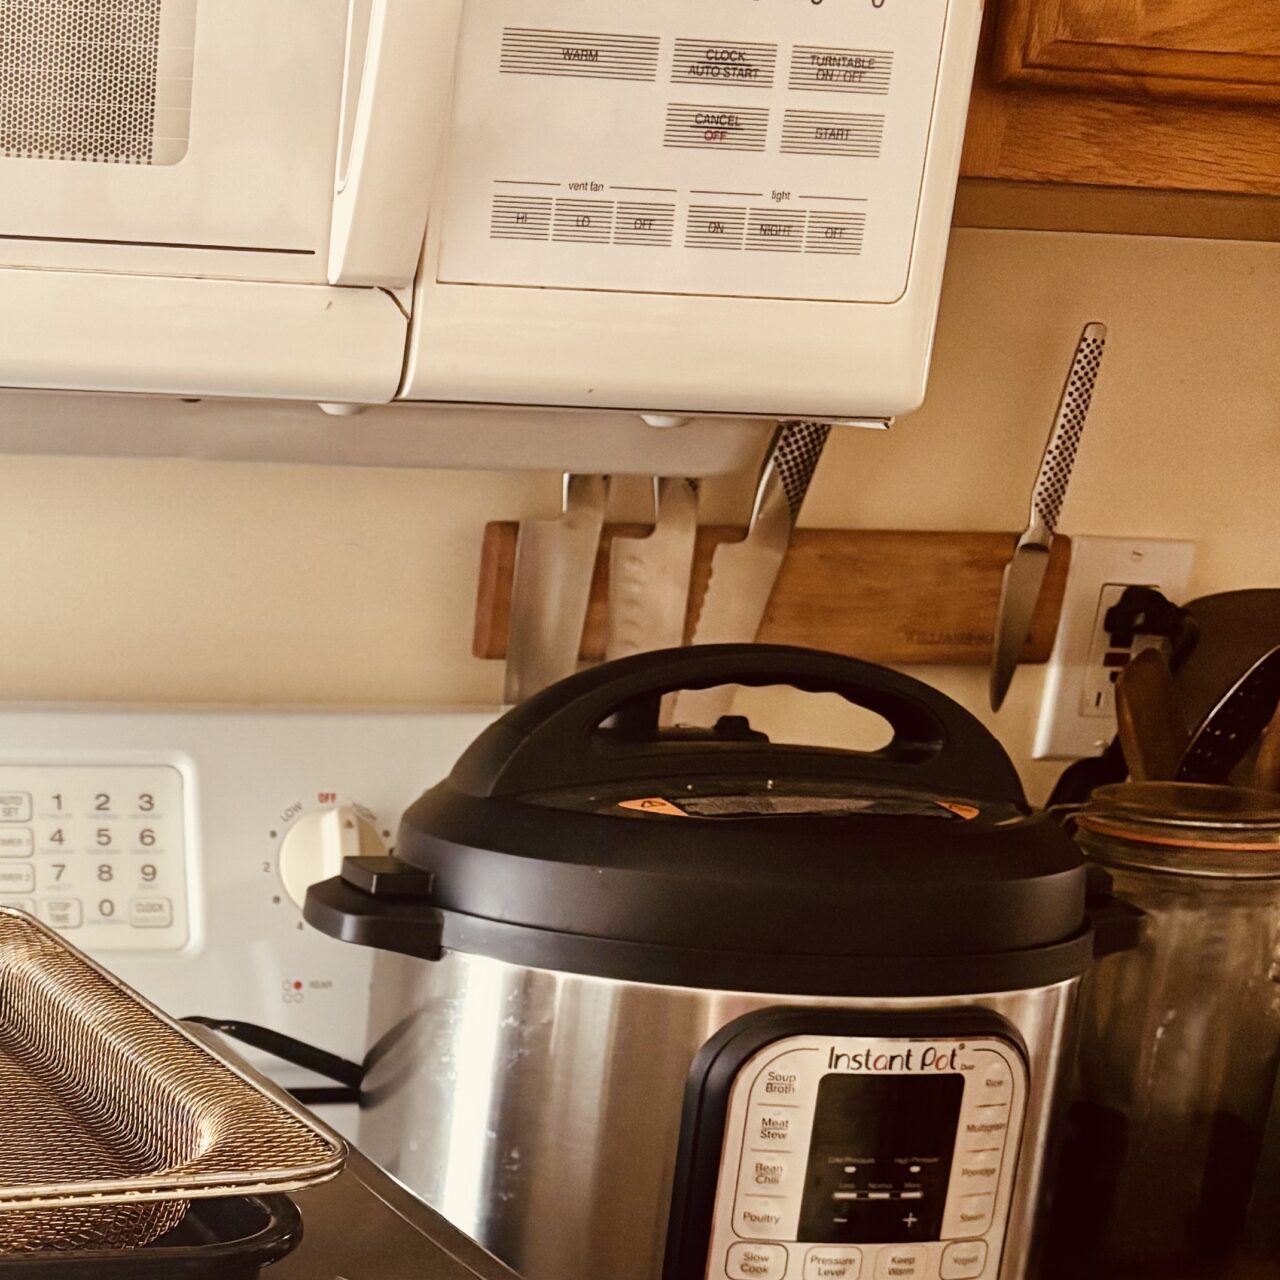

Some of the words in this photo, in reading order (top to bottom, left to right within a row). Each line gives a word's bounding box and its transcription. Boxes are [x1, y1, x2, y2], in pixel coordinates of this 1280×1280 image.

[562, 48, 599, 62] WARM
[705, 49, 746, 62] CLOCK
[810, 54, 876, 70] TURNTABLE
[688, 65, 721, 77] AUTO
[722, 67, 759, 79] START
[815, 69, 834, 81] ON
[694, 113, 741, 127] CANCEL
[704, 130, 728, 142] OFF
[814, 127, 851, 141] START
[568, 182, 588, 192] vent
[589, 181, 604, 192] fan
[52, 793, 63, 811] 1
[94, 793, 111, 811] 2
[138, 793, 155, 812] 3
[318, 792, 337, 804] OFF
[281, 802, 303, 823] LOW
[49, 829, 65, 846] 4
[96, 828, 112, 846] 5
[139, 829, 156, 846] 6
[51, 864, 66, 881] 7
[97, 864, 114, 882] 8
[140, 864, 158, 882] 9
[262, 861, 271, 873] 2
[98, 899, 115, 917] 0
[827, 1046, 914, 1071] Instant
[920, 1047, 958, 1071] Pot
[768, 1071, 797, 1084] Soup
[765, 1082, 795, 1094] Broth
[761, 1117, 789, 1129] Meat
[760, 1129, 788, 1140] Stew
[742, 1211, 781, 1225] Poultry
[743, 1251, 770, 1262] Slow
[810, 1255, 856, 1266] Pressure
[740, 1263, 769, 1274] Cook
[817, 1267, 846, 1278] Level
